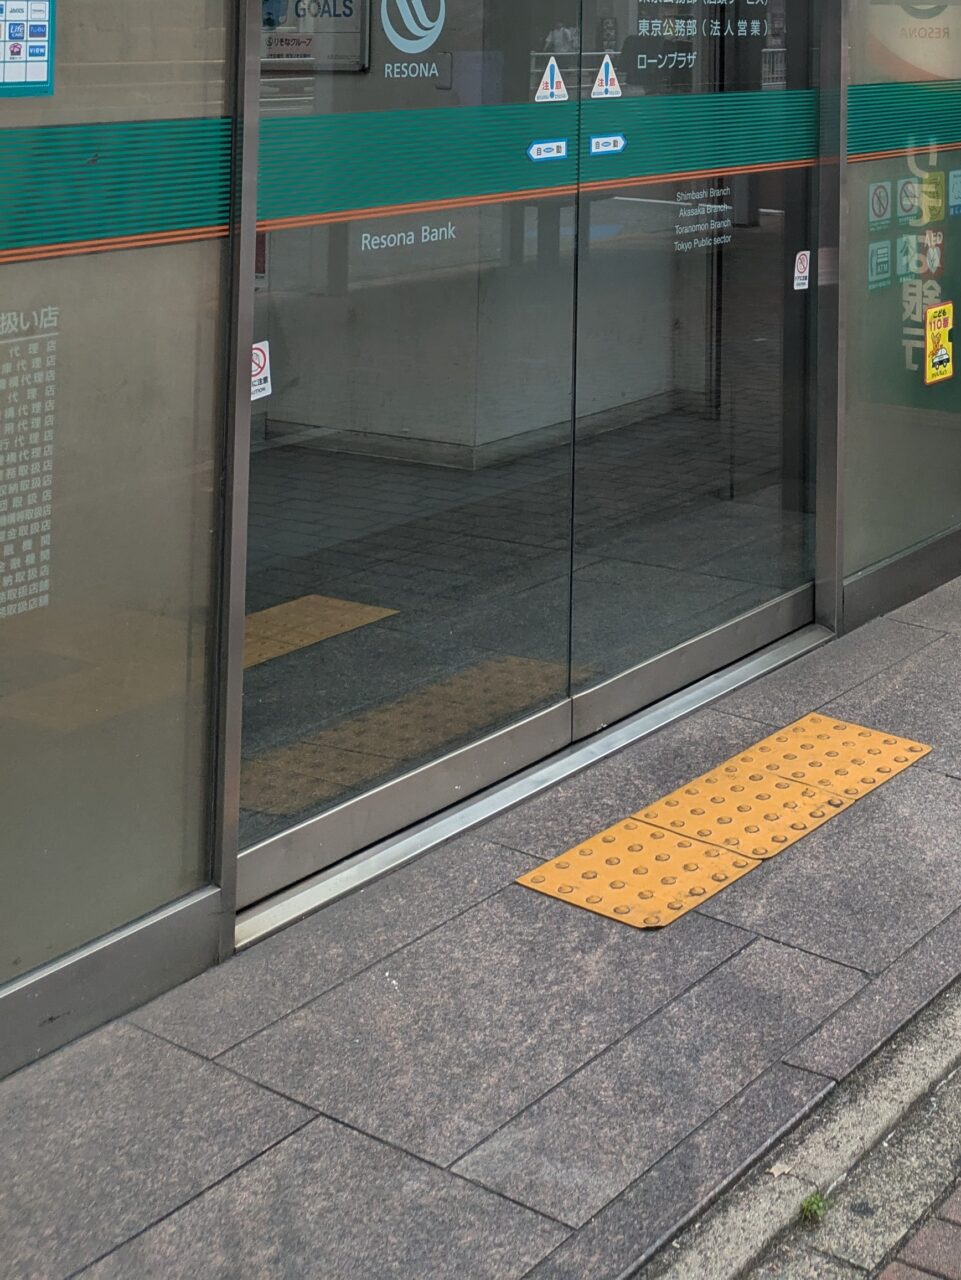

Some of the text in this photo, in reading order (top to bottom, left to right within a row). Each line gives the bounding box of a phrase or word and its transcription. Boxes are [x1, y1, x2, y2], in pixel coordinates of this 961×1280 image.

[274, 37, 312, 47] りそなグループ
[637, 52, 697, 68] ローンプラザ
[385, 63, 439, 77] RESONA
[676, 186, 731, 202] Shimbashi Branch
[678, 202, 728, 217] Akasaka Branch
[674, 219, 731, 234] Toranomon Branch
[361, 221, 456, 251] Resona Bank
[673, 234, 732, 253] Tokyo Public sector
[924, 230, 943, 247] AED
[933, 309, 947, 319] こども
